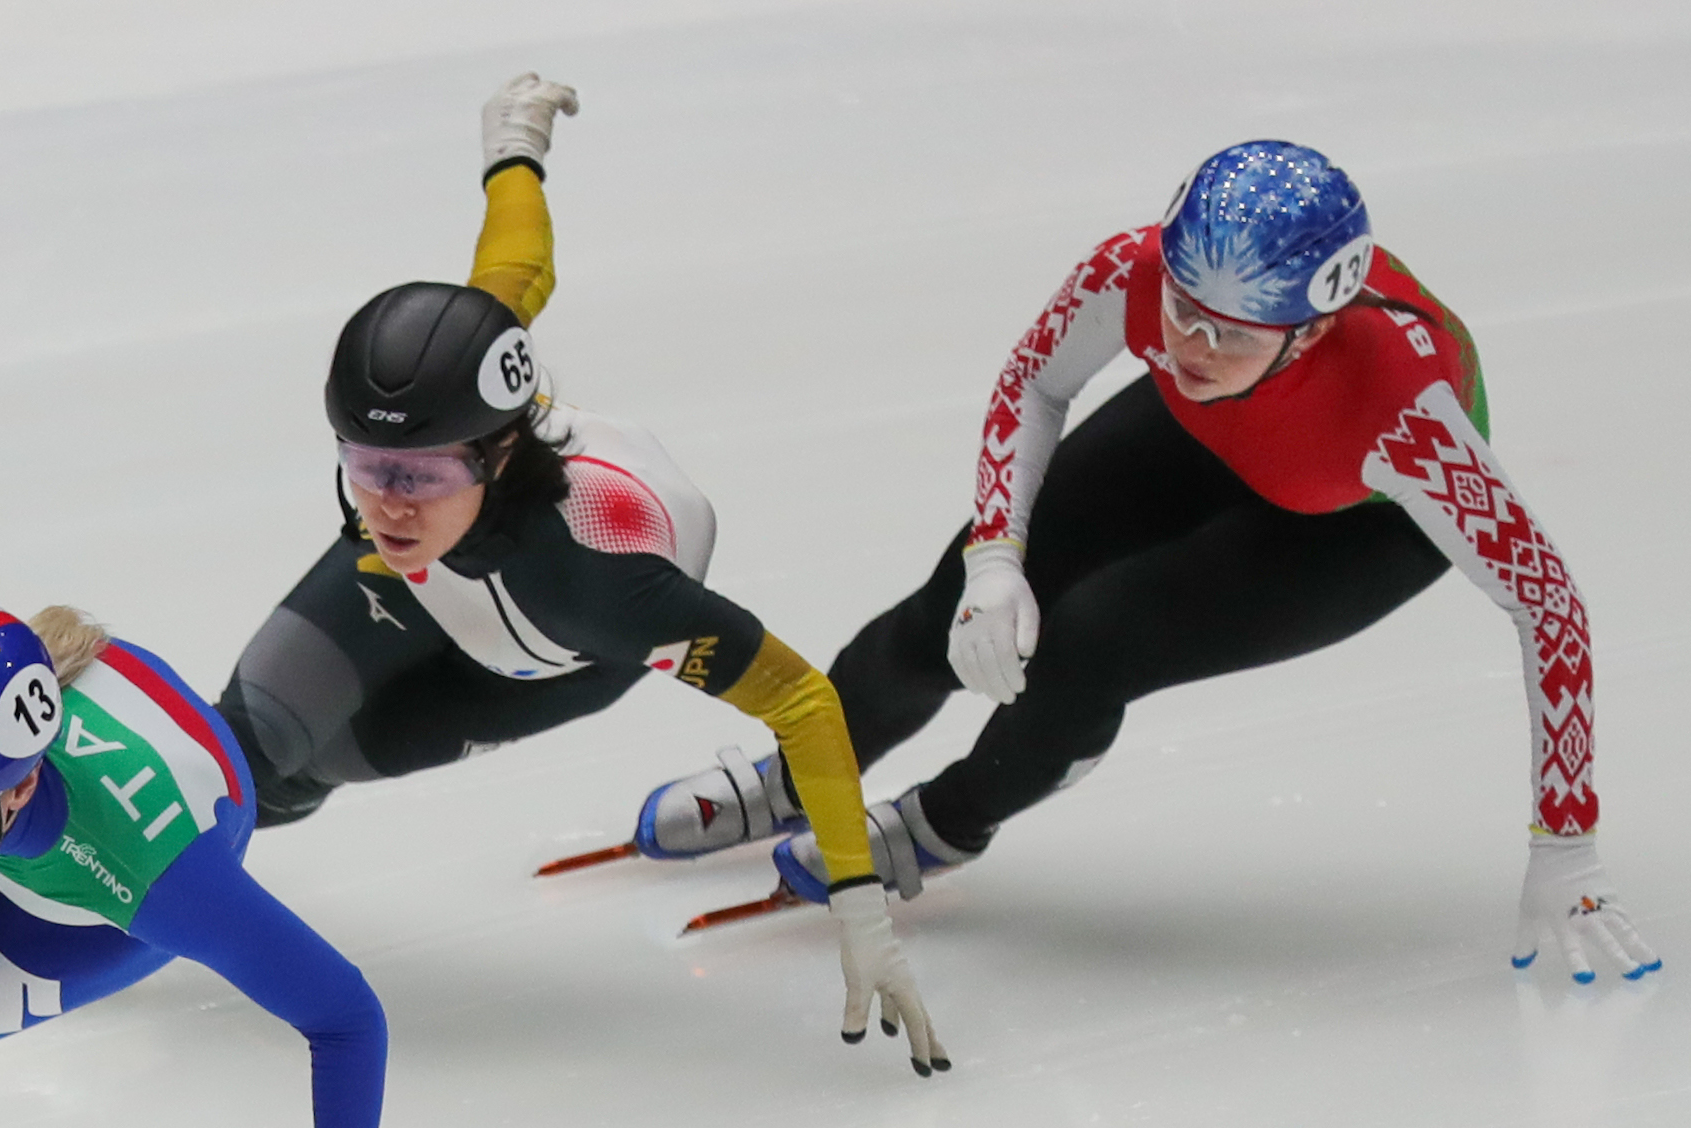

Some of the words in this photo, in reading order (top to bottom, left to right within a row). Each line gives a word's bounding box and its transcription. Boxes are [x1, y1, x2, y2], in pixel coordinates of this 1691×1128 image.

[1325, 243, 1370, 301] 13
[500, 339, 533, 395] 65
[681, 636, 719, 688] JPN
[13, 678, 56, 737] 13
[65, 714, 184, 842] ITA
[60, 834, 133, 904] TRENTINO
